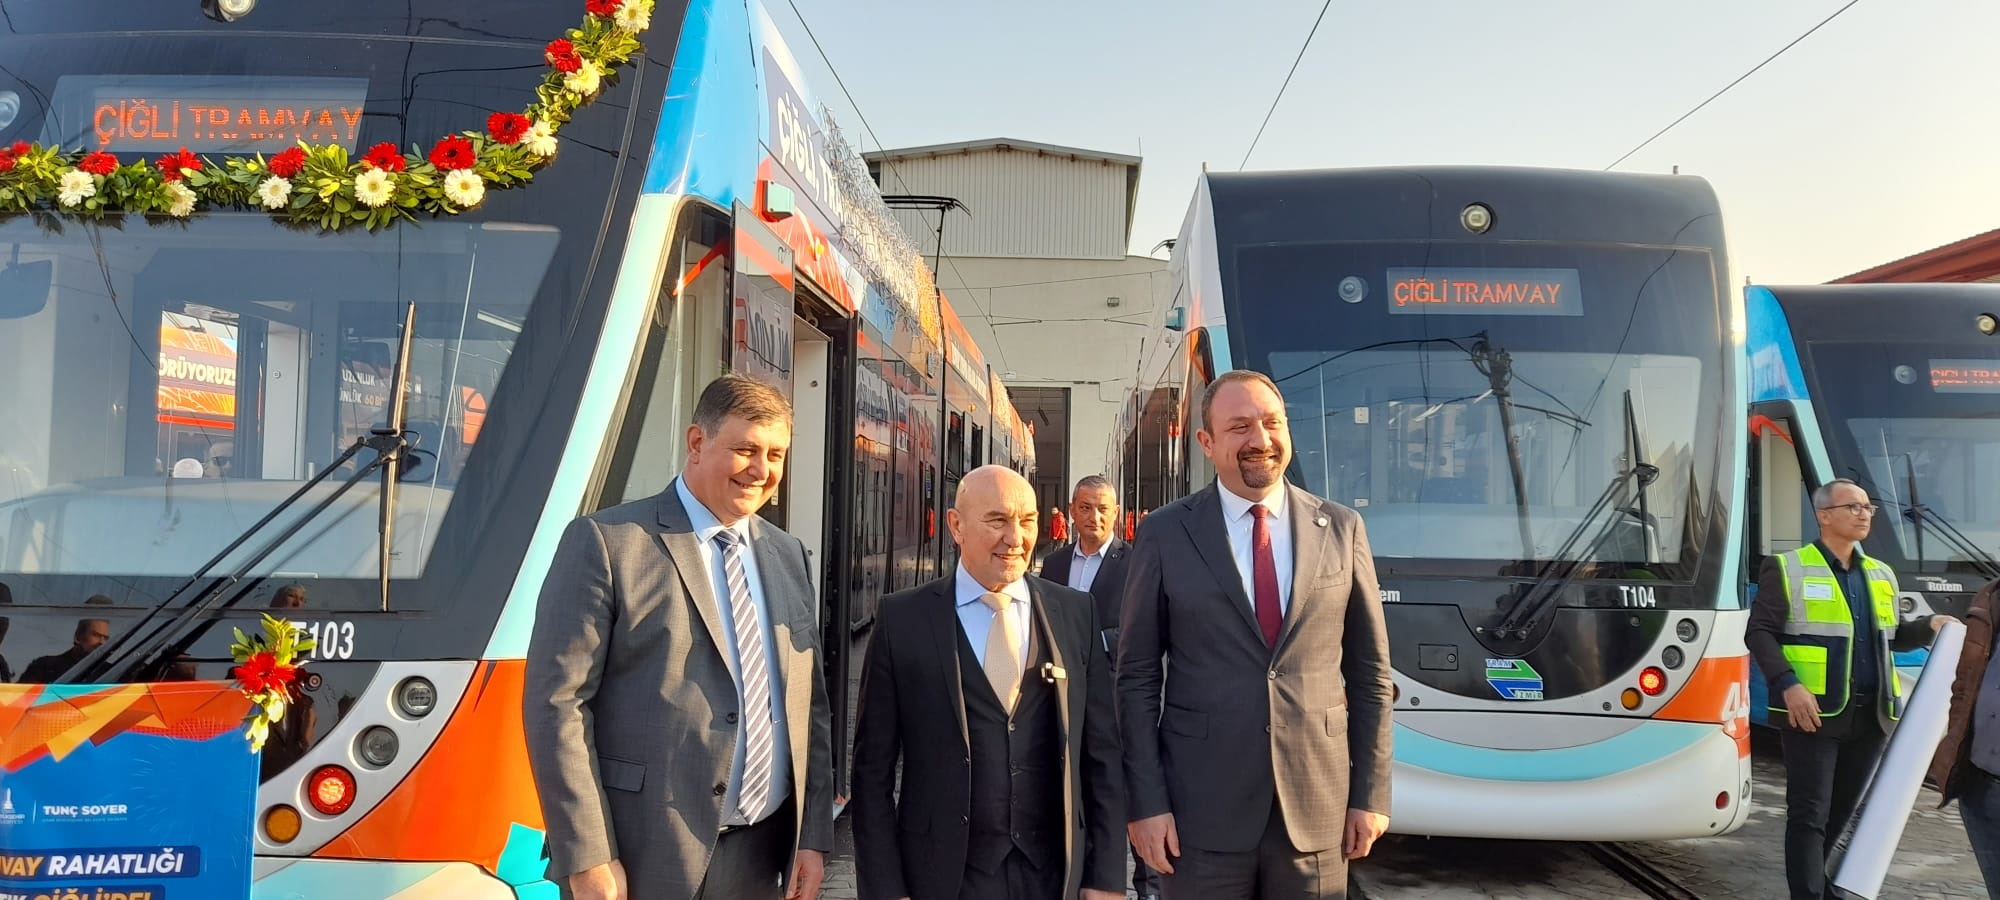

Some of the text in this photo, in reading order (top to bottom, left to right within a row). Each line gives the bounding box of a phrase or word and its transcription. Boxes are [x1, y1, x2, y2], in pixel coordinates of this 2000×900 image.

[94, 98, 364, 145] ÇİĞLİ TRAMVAY
[1394, 278, 1561, 307] ÇİĞLİ TRAMVAY
[1619, 585, 1656, 608] T104
[1928, 580, 1963, 592] Rotem
[290, 620, 355, 660] T103
[42, 804, 128, 818] TUNÇ SOYER
[0, 847, 184, 877] VAY RAHATLIĞI
